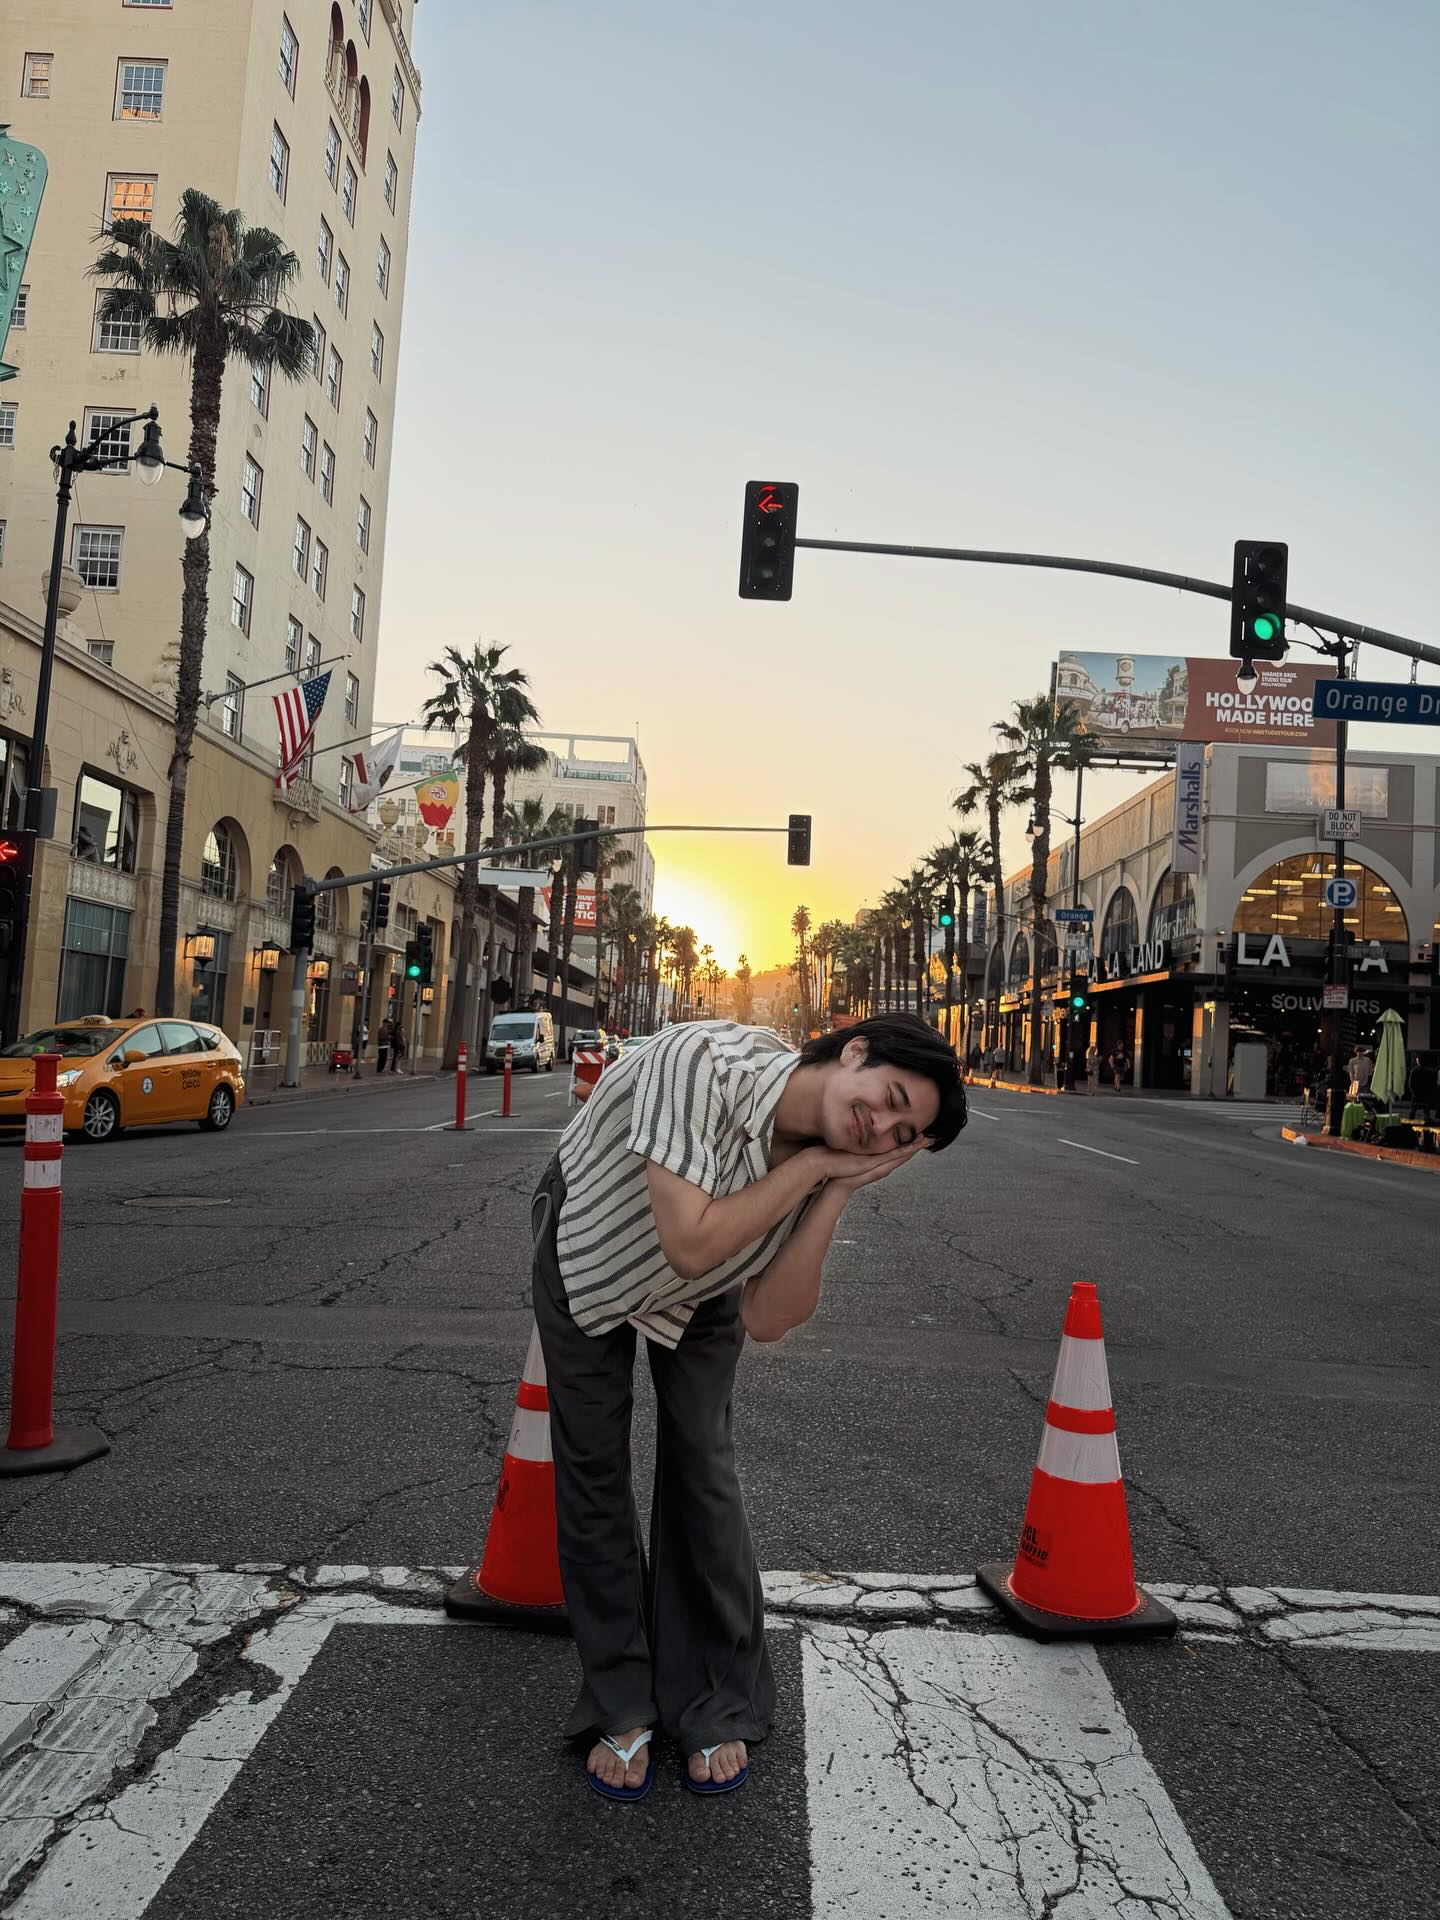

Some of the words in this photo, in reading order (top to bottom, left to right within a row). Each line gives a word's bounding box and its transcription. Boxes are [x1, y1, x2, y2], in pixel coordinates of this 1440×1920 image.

[1206, 692, 1313, 712] HOLLYWOO
[1326, 688, 1408, 718] Orange
[1216, 709, 1266, 725] MADE
[1269, 711, 1315, 727] HERE
[1178, 761, 1201, 855] Marshalls
[1328, 811, 1340, 821] DO
[1342, 812, 1357, 822] NOT
[1330, 821, 1355, 831] BLOCK
[1061, 911, 1089, 921] Orange
[1130, 939, 1164, 975] LAND
[1237, 932, 1291, 967] LA
[1271, 993, 1381, 1014] SOUVIRS
